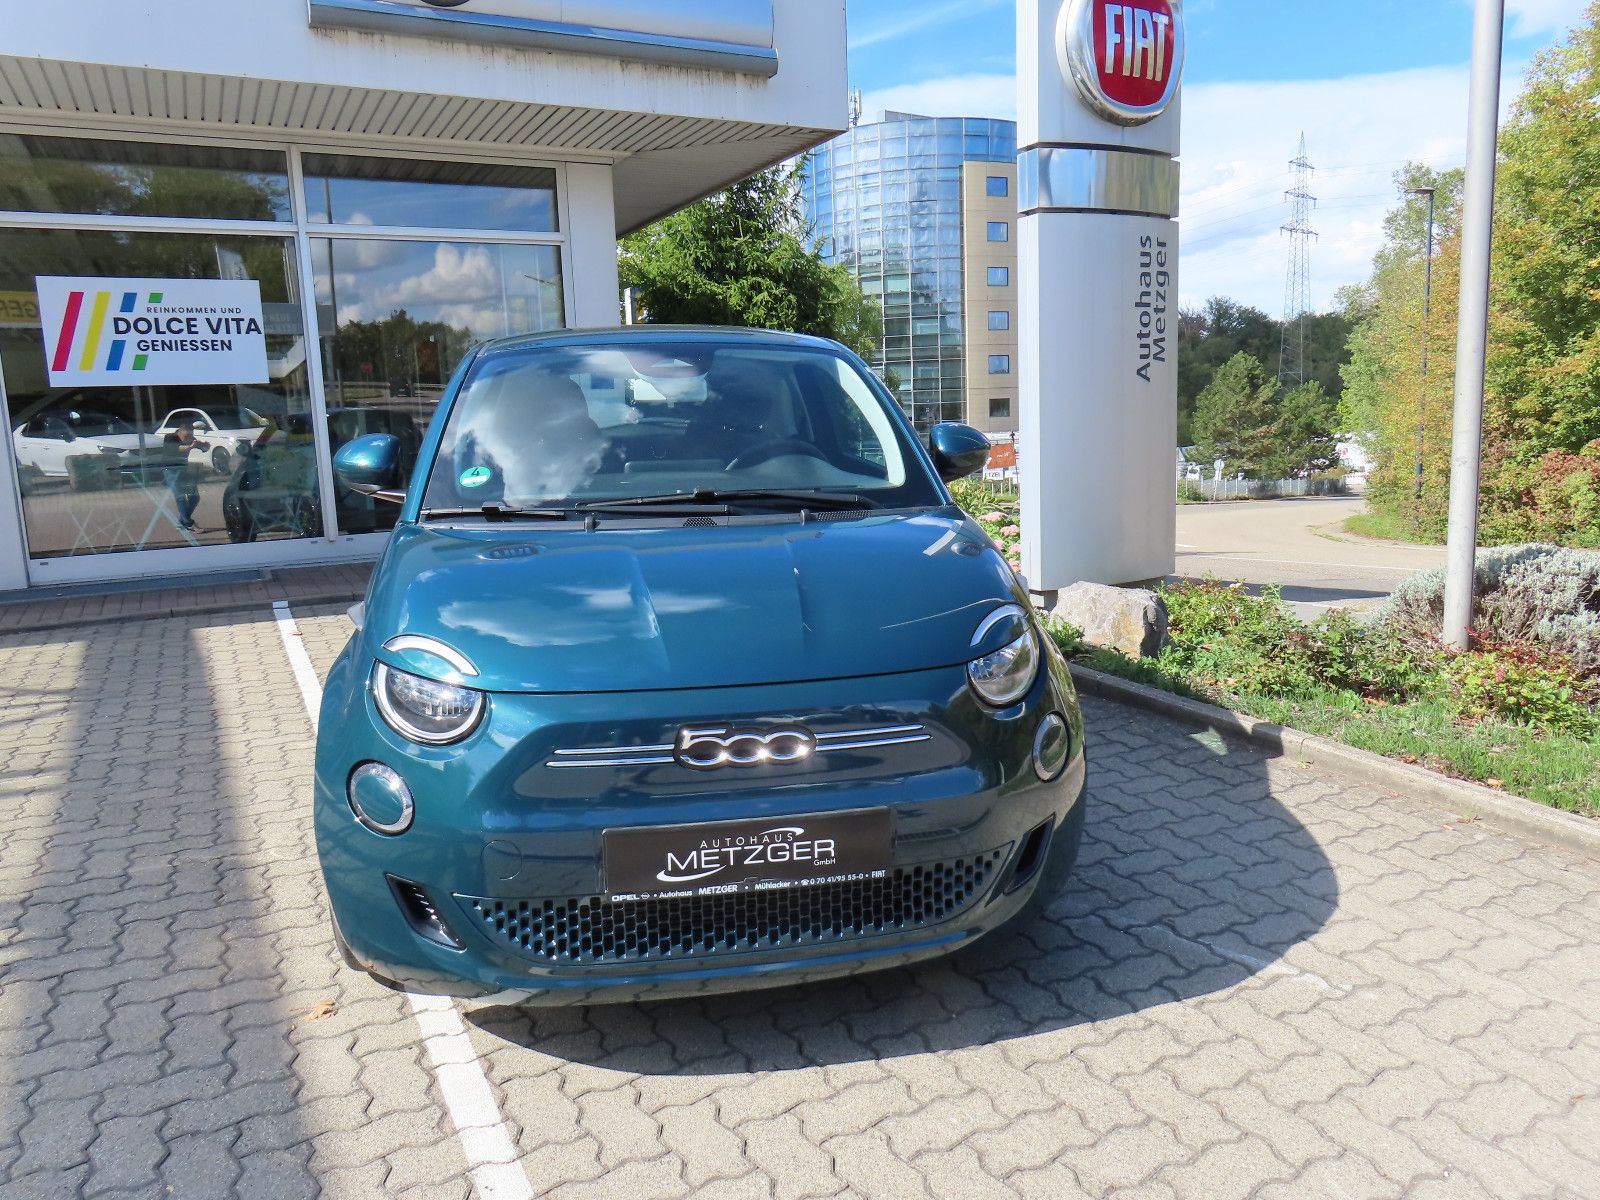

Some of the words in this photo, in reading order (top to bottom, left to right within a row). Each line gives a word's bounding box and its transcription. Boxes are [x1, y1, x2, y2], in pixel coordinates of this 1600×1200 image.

[1104, 3, 1169, 82] FIAT
[146, 306, 217, 314] REINKOMMEN
[1135, 235, 1152, 382] Autohaus
[1152, 237, 1170, 362] Metzger
[113, 317, 199, 335] DOLCE
[205, 317, 262, 335] VITA
[137, 339, 233, 352] GENIESSEN
[471, 468, 480, 476] 4
[678, 725, 813, 768] 500
[700, 832, 793, 849] AUTOHAUS
[667, 839, 835, 871] METZGER
[813, 857, 836, 866] GmbH
[611, 893, 640, 902] OPEL
[659, 889, 693, 899] Autohaus
[698, 884, 738, 895] METZGER
[754, 880, 791, 890] Mühlacker
[871, 869, 886, 879] FIAT
